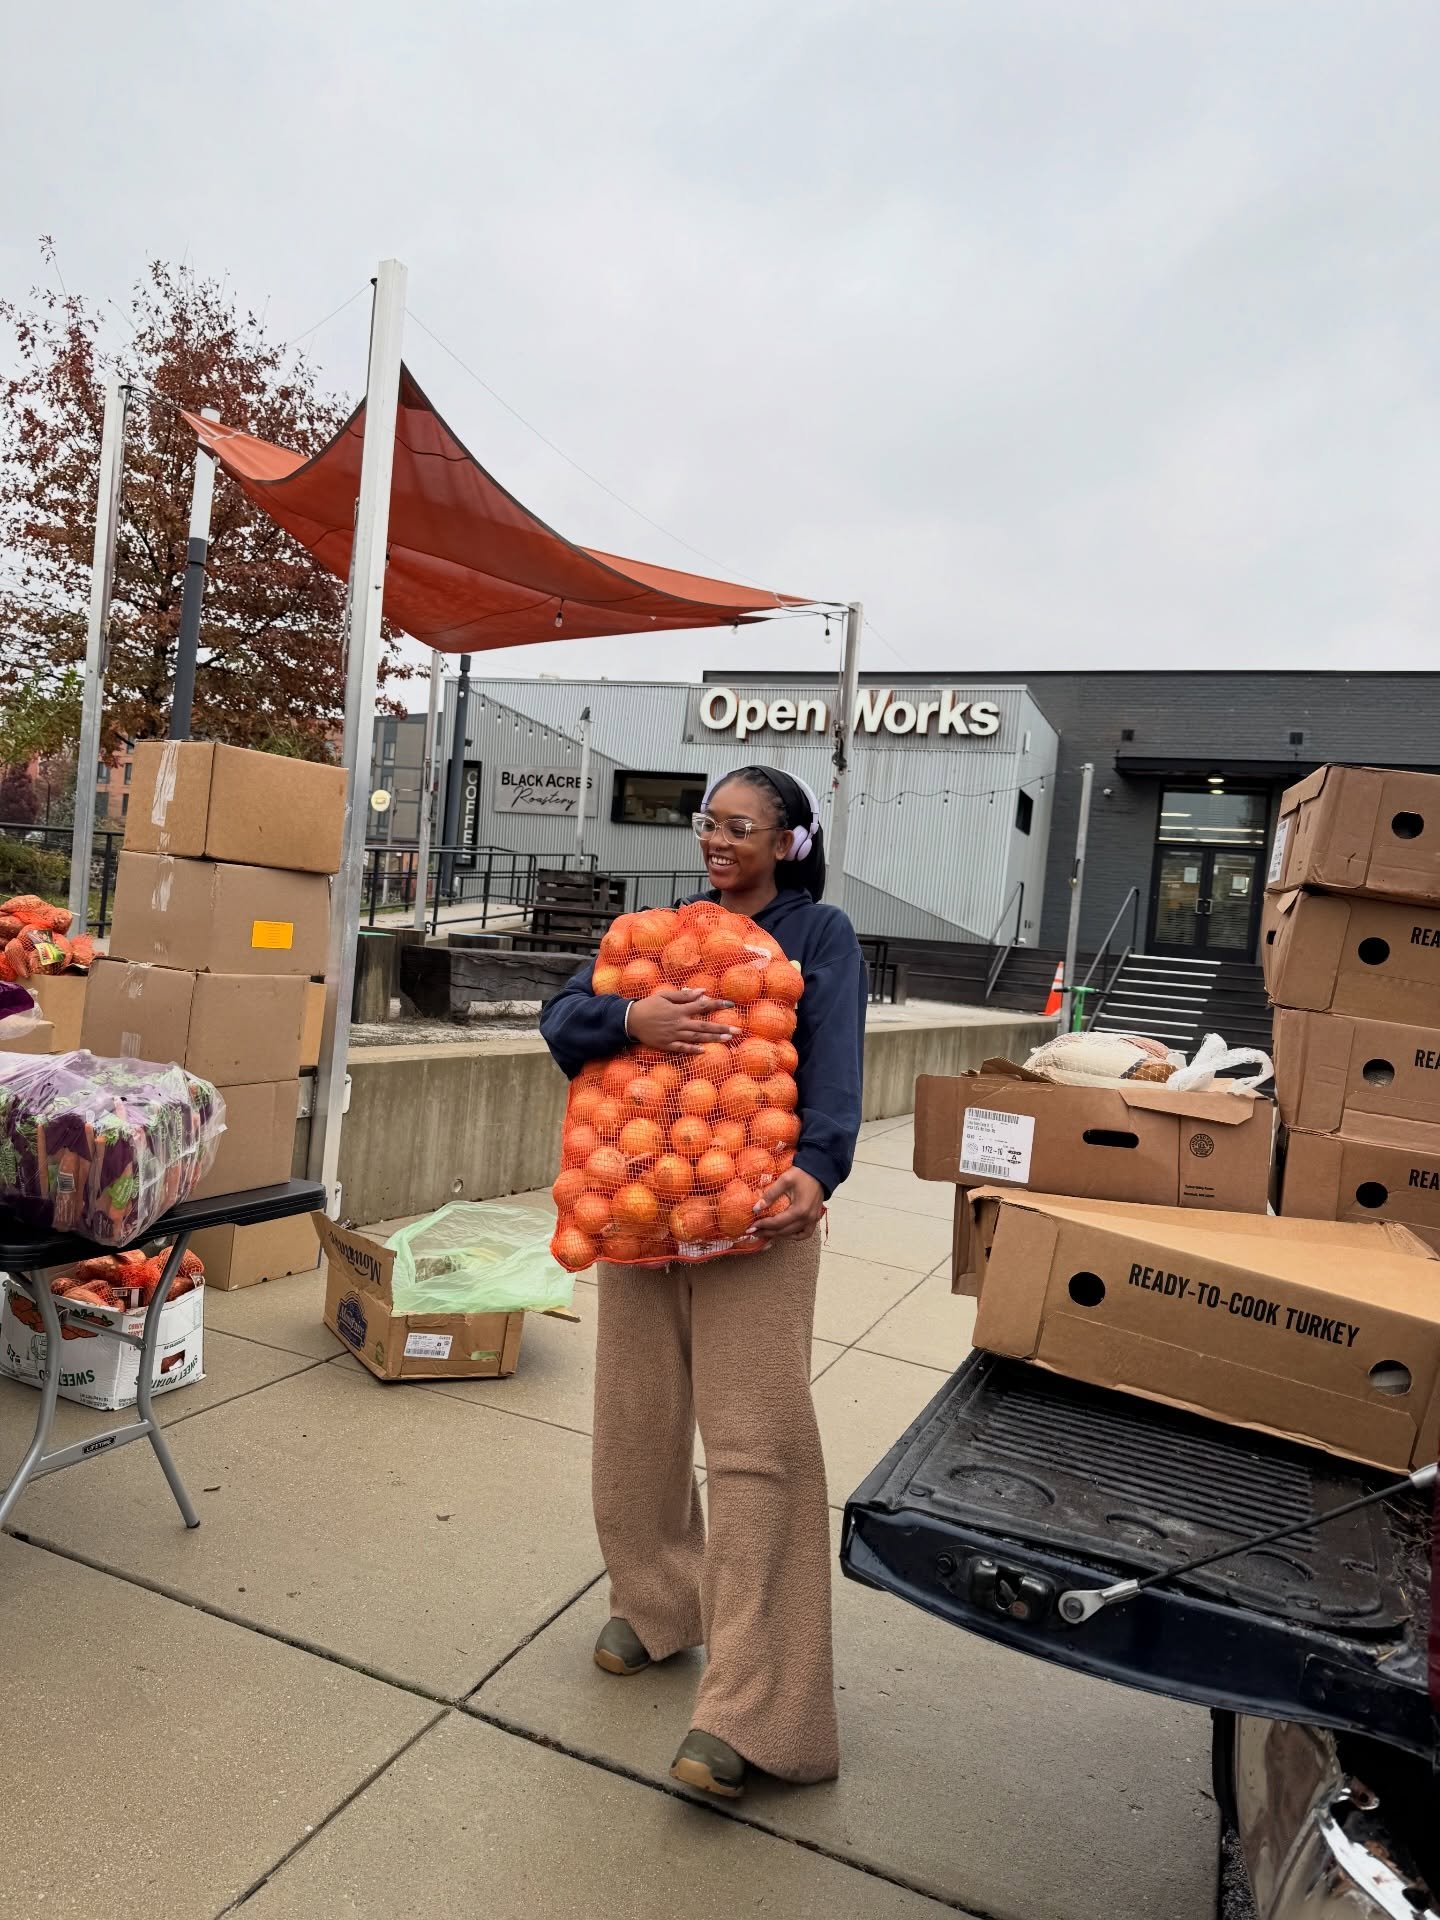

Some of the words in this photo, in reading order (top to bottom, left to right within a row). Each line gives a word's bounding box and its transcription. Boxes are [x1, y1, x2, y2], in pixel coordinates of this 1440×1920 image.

[700, 687, 827, 739] Open
[853, 689, 1000, 736] Works
[501, 772, 544, 787] BLACK
[545, 774, 593, 789] ACRES
[511, 785, 577, 812] Roastery
[1128, 1263, 1281, 1326] READY-TO-COOK
[1285, 1307, 1361, 1348] TURKEY
